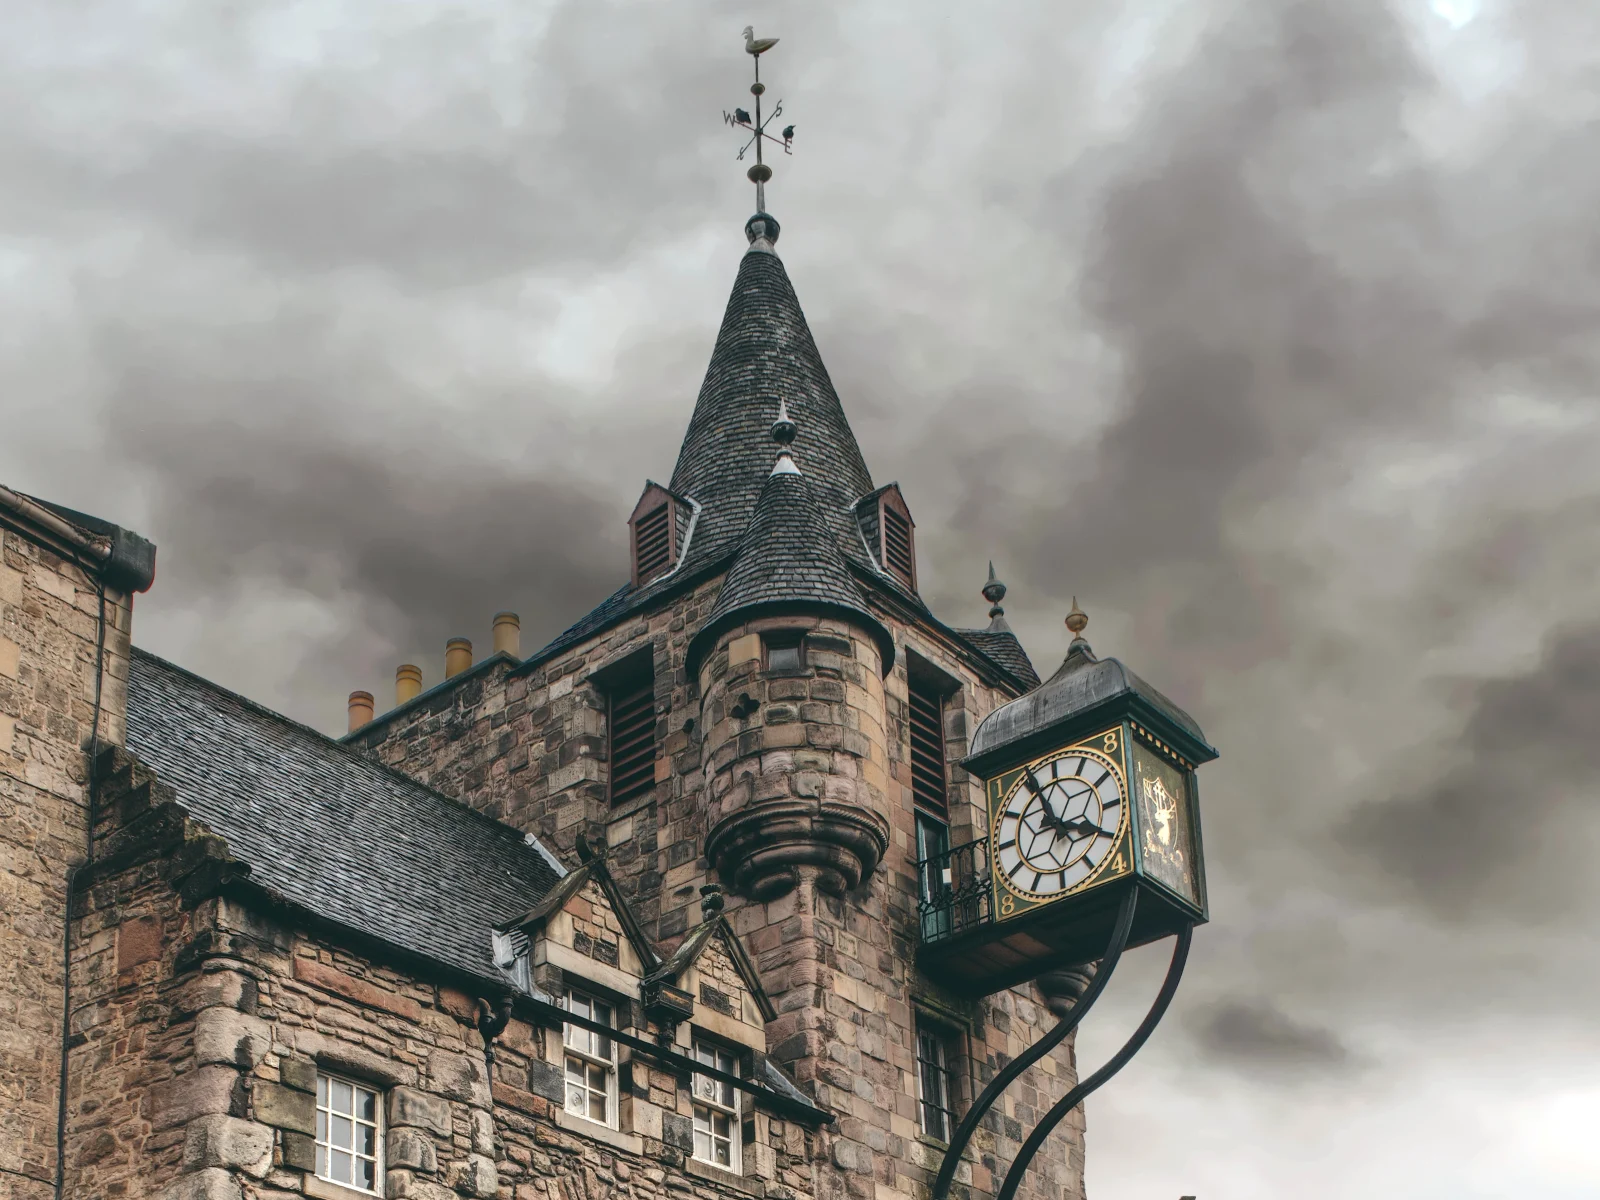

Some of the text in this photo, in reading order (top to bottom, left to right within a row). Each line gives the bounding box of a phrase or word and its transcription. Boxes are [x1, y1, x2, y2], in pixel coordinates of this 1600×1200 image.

[723, 110, 735, 128] W
[1103, 732, 1118, 753] 8
[1001, 852, 1127, 915] 8 4
